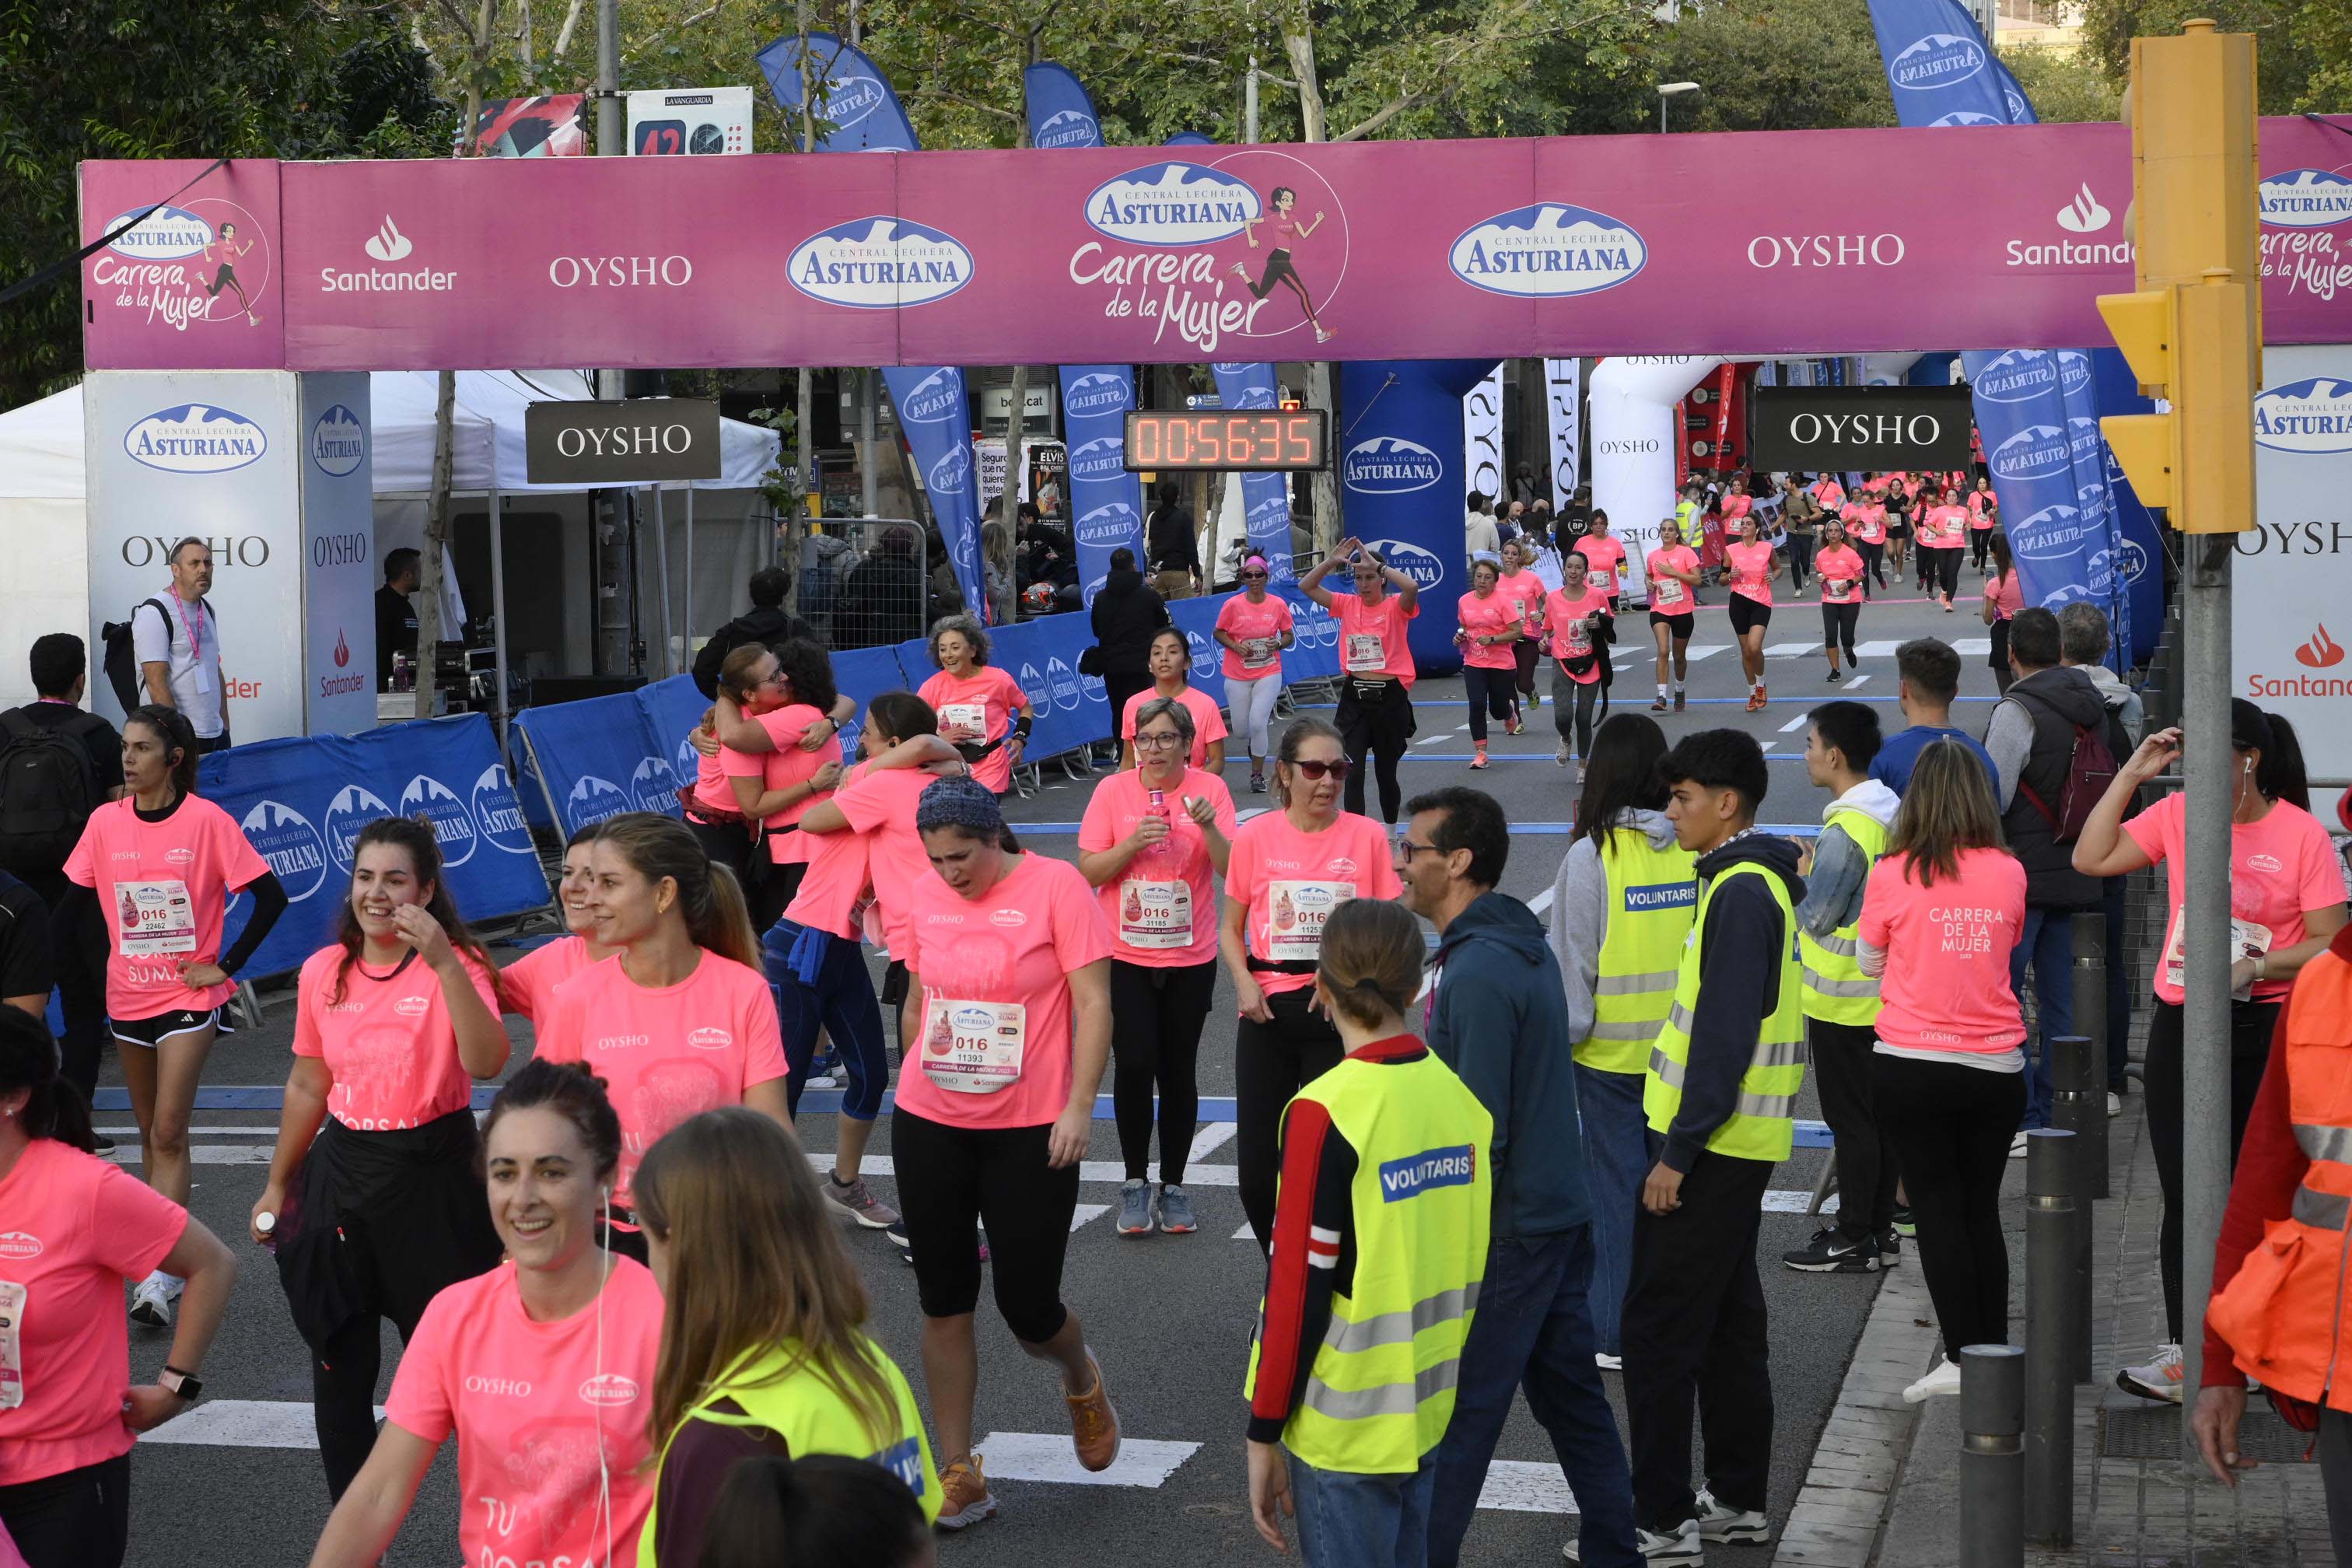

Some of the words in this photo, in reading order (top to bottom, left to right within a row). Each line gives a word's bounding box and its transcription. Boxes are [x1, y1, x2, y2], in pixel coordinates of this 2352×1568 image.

[1186, 190, 1242, 198] LECHERA
[1097, 194, 1247, 225] ASTURIANA
[1495, 236, 1556, 246] CENTRAL
[1562, 234, 1625, 243] LECHERA
[830, 249, 888, 257] CENTRAL
[894, 247, 954, 256] LECHERA
[1465, 239, 1632, 274] ASTURIANA
[1748, 233, 1905, 268] OYSHO
[93, 256, 185, 285] Carrera
[801, 250, 960, 285] ASTURIANA
[1069, 241, 1215, 285] Carrera
[2277, 255, 2291, 276] la
[321, 267, 457, 292] Santander
[549, 255, 693, 288] OYSHO
[117, 287, 133, 307] de
[137, 287, 149, 307] la
[147, 282, 220, 331] Mujer
[1105, 287, 1132, 317] de
[1138, 286, 1158, 317] la
[1153, 280, 1270, 353] Mujer
[1626, 355, 1690, 365] OYSHO
[2276, 404, 2328, 412] CENTRAL
[207, 427, 252, 436] LECHERA
[1790, 413, 1940, 446] OYSHO
[135, 429, 257, 457] ASTURIANA
[316, 431, 362, 460] ASTURIANA
[557, 425, 691, 457] OYSHO
[1137, 418, 1311, 462] 00:56:35
[1600, 438, 1659, 455] OYSHO
[1040, 453, 1064, 462] ELVIS
[982, 465, 997, 474] que
[1347, 460, 1436, 481] ASTURIANA
[121, 535, 269, 568] OYHO
[314, 531, 366, 568] OYSHO
[321, 673, 364, 698] Santander
[436, 803, 460, 814] LECHERA
[341, 819, 363, 831] CENTRAL
[254, 835, 282, 849] CENTRAL
[282, 829, 311, 842] LECHERA
[112, 851, 141, 861] OYSHO
[1265, 858, 1300, 870] OYSHO
[2250, 859, 2280, 870] ASTURIANA
[1626, 888, 1696, 906] VOLUNTARIS
[142, 909, 167, 920] 016
[927, 914, 964, 924] OYSHO
[1144, 908, 1169, 918] 016
[1298, 912, 1326, 923] 016
[1929, 908, 2004, 924] CARRERA
[1944, 922, 1964, 937] DE
[1970, 924, 1990, 938] LA
[1941, 938, 1991, 953] MUJER
[327, 1002, 364, 1014] SHO
[955, 1017, 991, 1027] ASTURIANA
[599, 1034, 649, 1051] OYSHO
[692, 1035, 729, 1045] ASTURIANA
[956, 1036, 988, 1052] 016
[1920, 1031, 1961, 1044] OYSHO
[957, 1054, 983, 1063] 11393
[932, 1063, 957, 1072] CARRERA
[930, 1075, 958, 1085] OYSHO
[1384, 1157, 1470, 1192] VOLUNTARIS
[466, 1375, 532, 1398] OYSHO
[585, 1386, 635, 1398] ASTURIANA
[480, 1496, 516, 1537] TU
